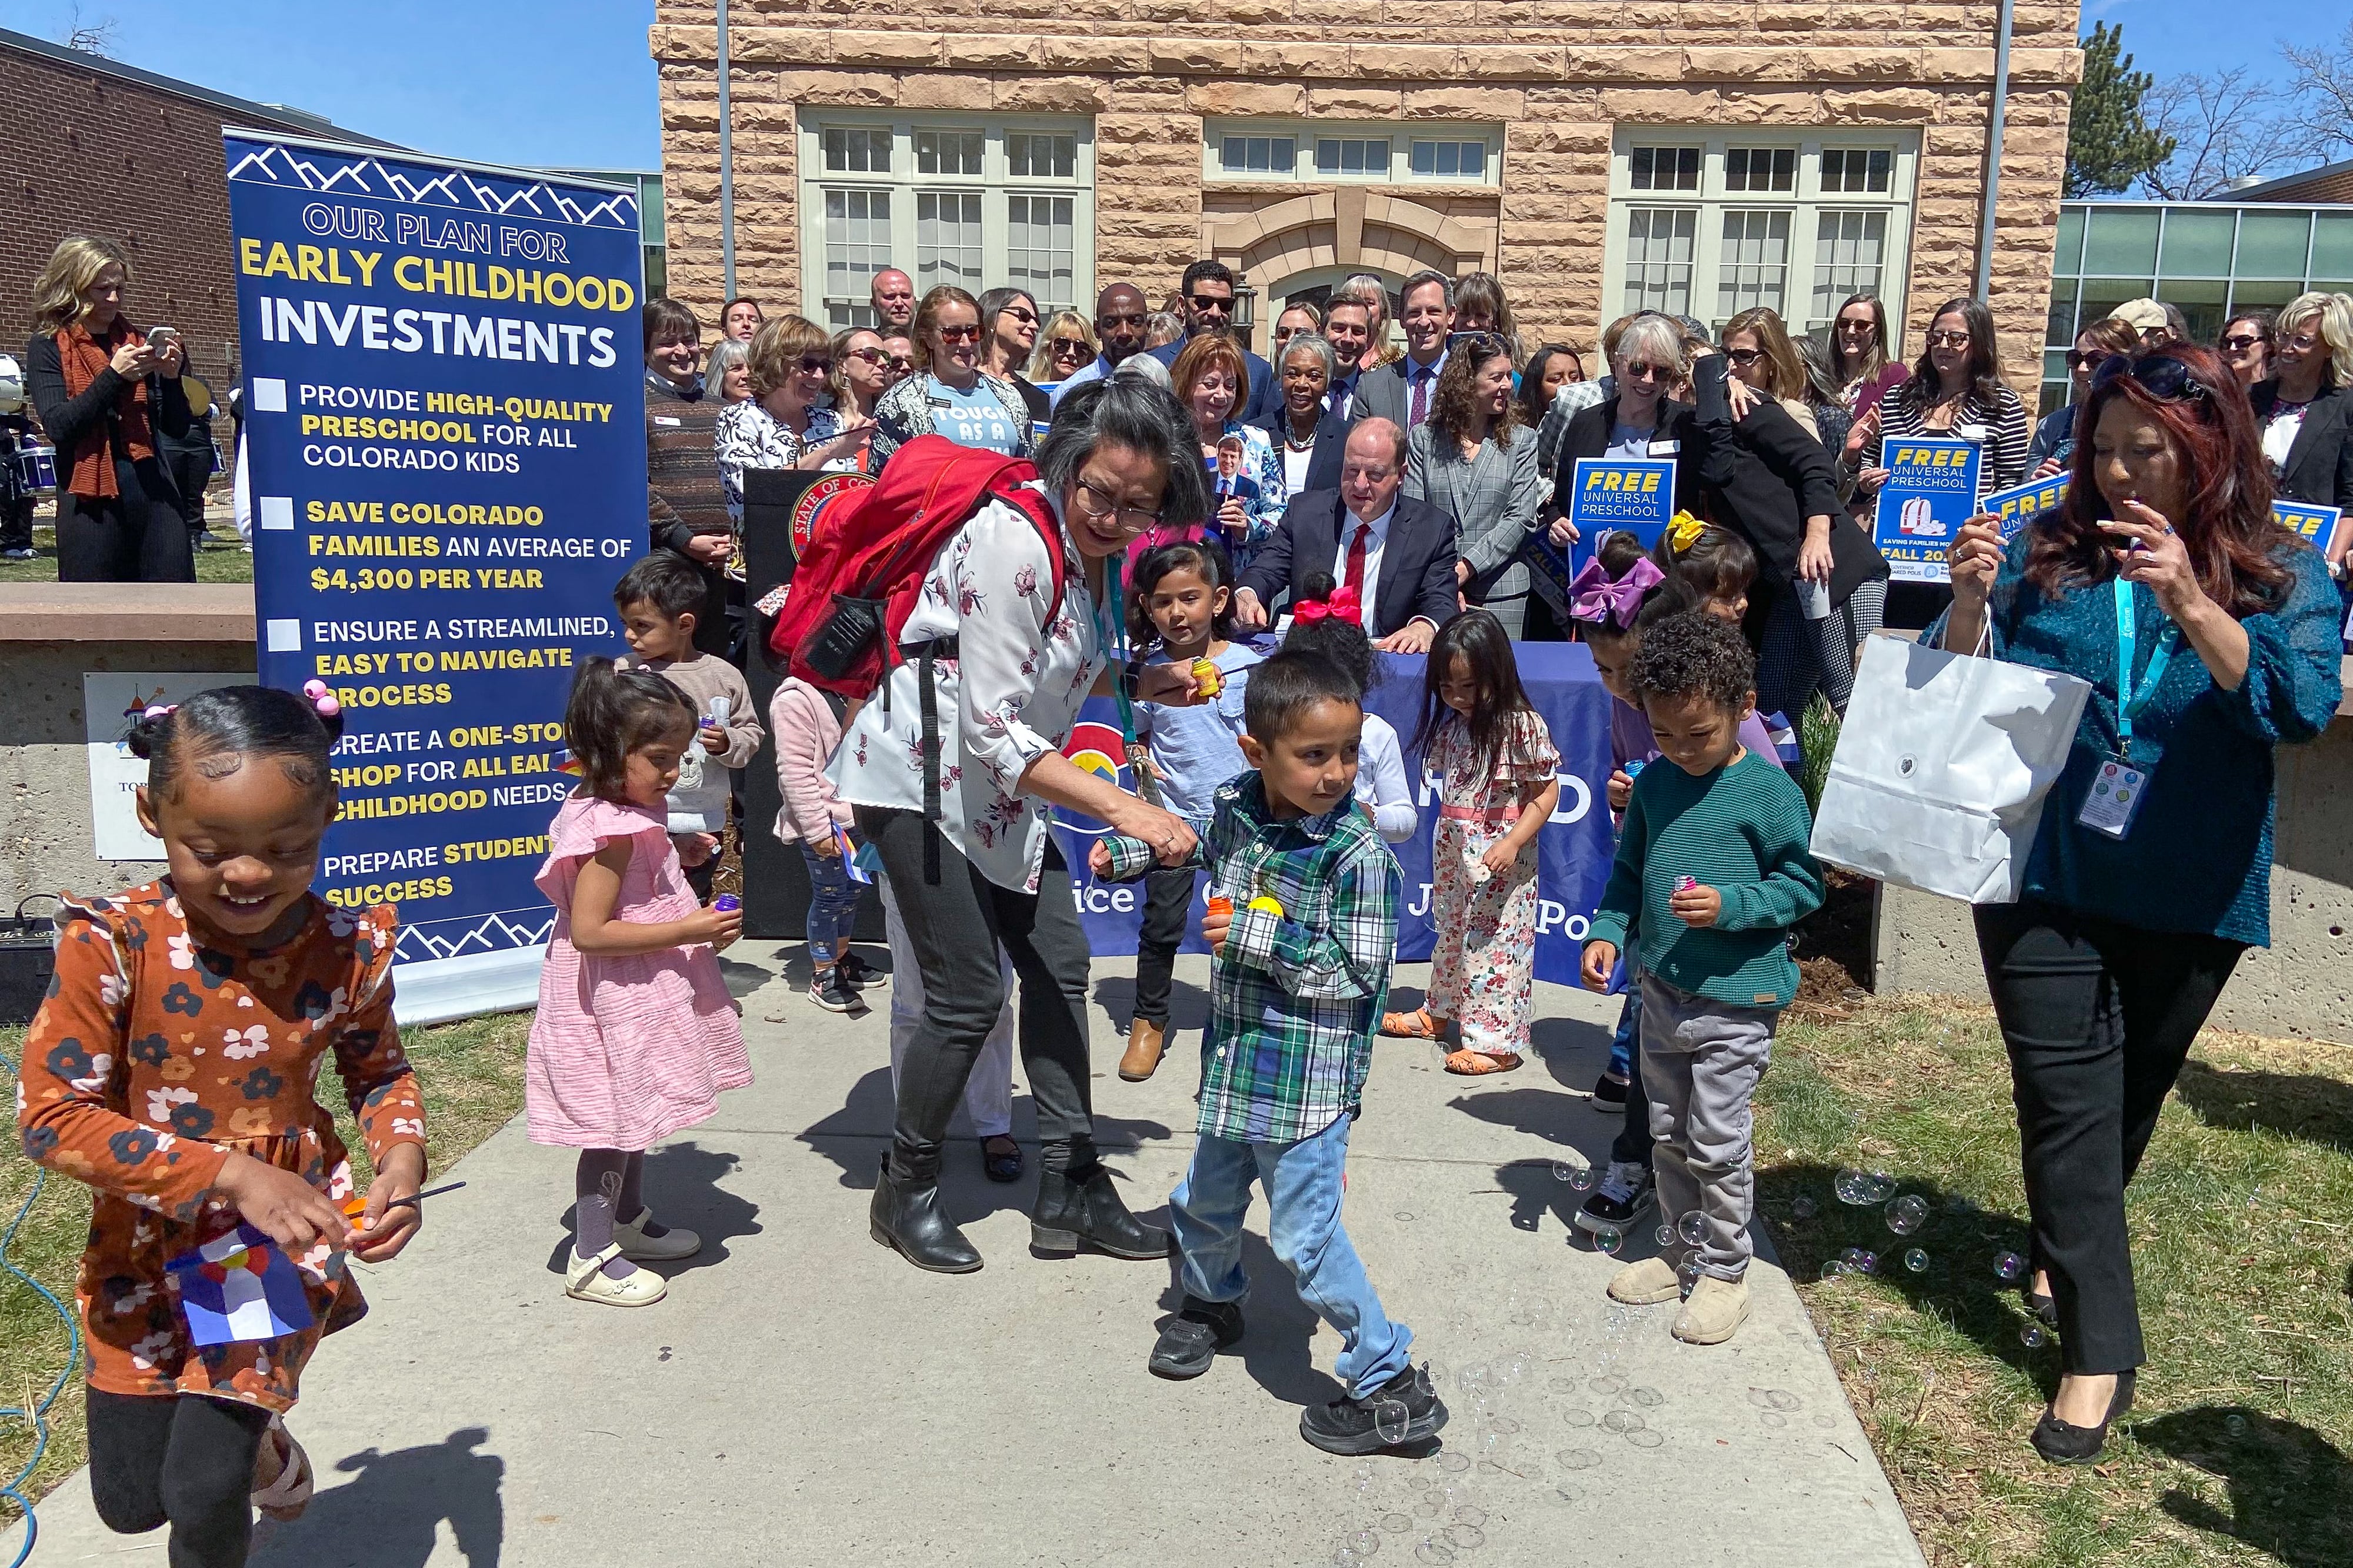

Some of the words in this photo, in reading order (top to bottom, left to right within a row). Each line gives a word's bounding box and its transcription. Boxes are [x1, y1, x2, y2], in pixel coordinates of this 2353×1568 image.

[302, 202, 390, 243] OUR
[396, 213, 491, 255] PLAN
[500, 226, 571, 263] FOR
[240, 238, 383, 286] EARLY
[394, 256, 635, 312] CHILDHOOD
[260, 296, 617, 368] INVESTMENTS
[299, 384, 419, 412] PROVIDE
[426, 392, 613, 423] HIGH-QUALITY
[302, 415, 476, 443] PRESCHOOL
[483, 425, 531, 446] FOR
[538, 428, 576, 448] ALL
[959, 422, 984, 441] AS
[991, 422, 1006, 441] A
[303, 445, 458, 471] COLORADO
[465, 452, 520, 473] KIDS
[1895, 449, 1969, 467] FREE
[1585, 471, 1662, 492] FREE
[1891, 477, 1967, 488] PRESCHOOL
[1892, 466, 1966, 477] UNIVERSAL
[795, 492, 819, 535] STATE
[822, 479, 840, 493] OF
[1582, 505, 1660, 516] PRESCHOOL
[1583, 492, 1659, 504] UNIVERSAL
[307, 501, 384, 523] SAVE
[390, 503, 544, 526] COLORADO
[309, 535, 439, 556] FAMILIES
[446, 538, 479, 556] AN
[486, 538, 595, 558] AVERAGE
[601, 539, 632, 558] OF
[1881, 548, 1919, 561] FALL
[311, 566, 414, 593] $4,300
[420, 569, 471, 589] PER
[476, 569, 543, 588] YEAR
[314, 620, 418, 642] ENSURE
[424, 620, 442, 639] A
[448, 617, 615, 639] STREAMLINED,
[316, 654, 389, 675] EASY
[396, 652, 434, 672] TO
[441, 648, 572, 670] NAVIGATE
[426, 730, 444, 749] A
[449, 722, 566, 749] ONE-STO
[407, 760, 456, 783] FOR
[462, 757, 506, 779] ALL
[493, 782, 566, 807] NEEDS
[324, 846, 438, 878] PREPARE
[325, 876, 453, 908] SUCCESS
